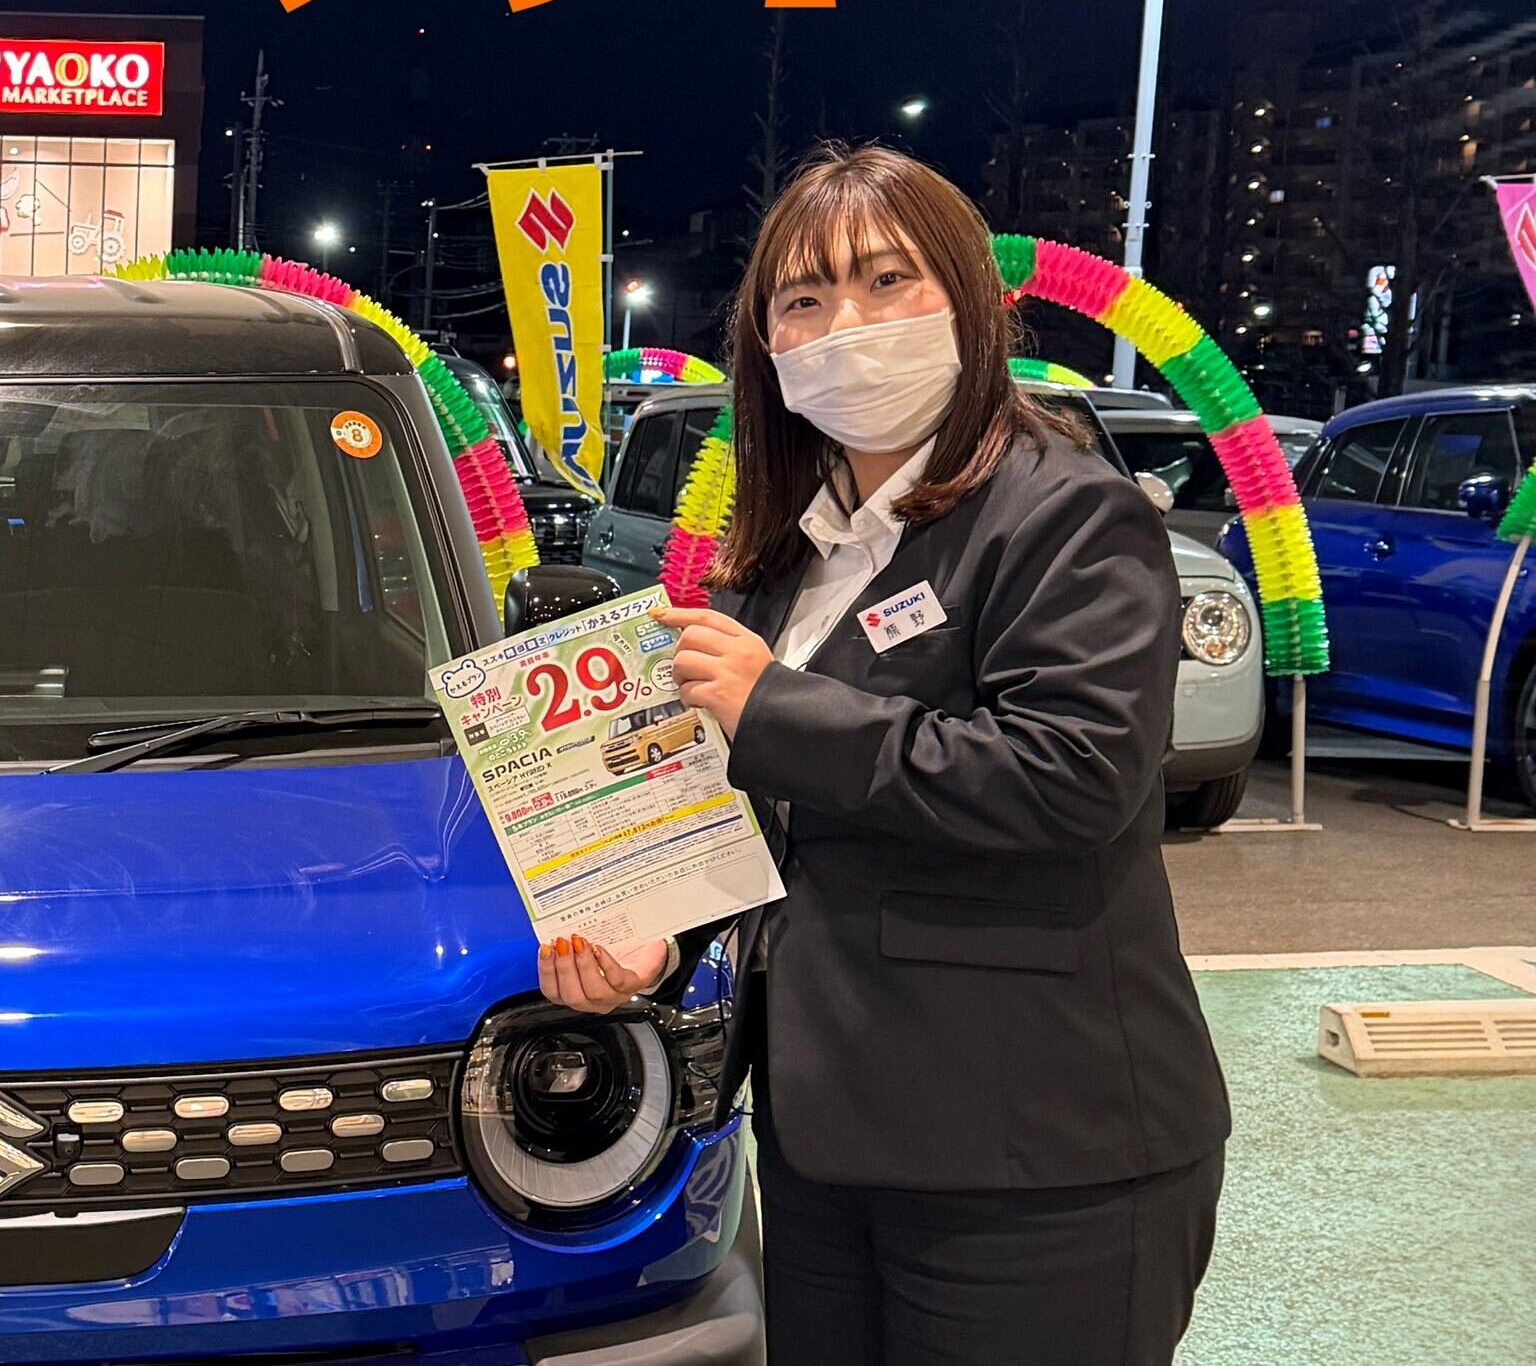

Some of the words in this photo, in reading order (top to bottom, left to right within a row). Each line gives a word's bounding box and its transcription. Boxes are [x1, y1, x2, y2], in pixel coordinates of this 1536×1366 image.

[4, 51, 149, 88] YAOKO
[2, 87, 148, 107] MARKETPLACE
[352, 429, 363, 442] 8
[882, 591, 926, 617] SUZUKI
[470, 686, 501, 709] 特別
[526, 647, 652, 732] 2.9%
[460, 696, 522, 726] キャンペーン
[482, 747, 552, 783] SPACIA
